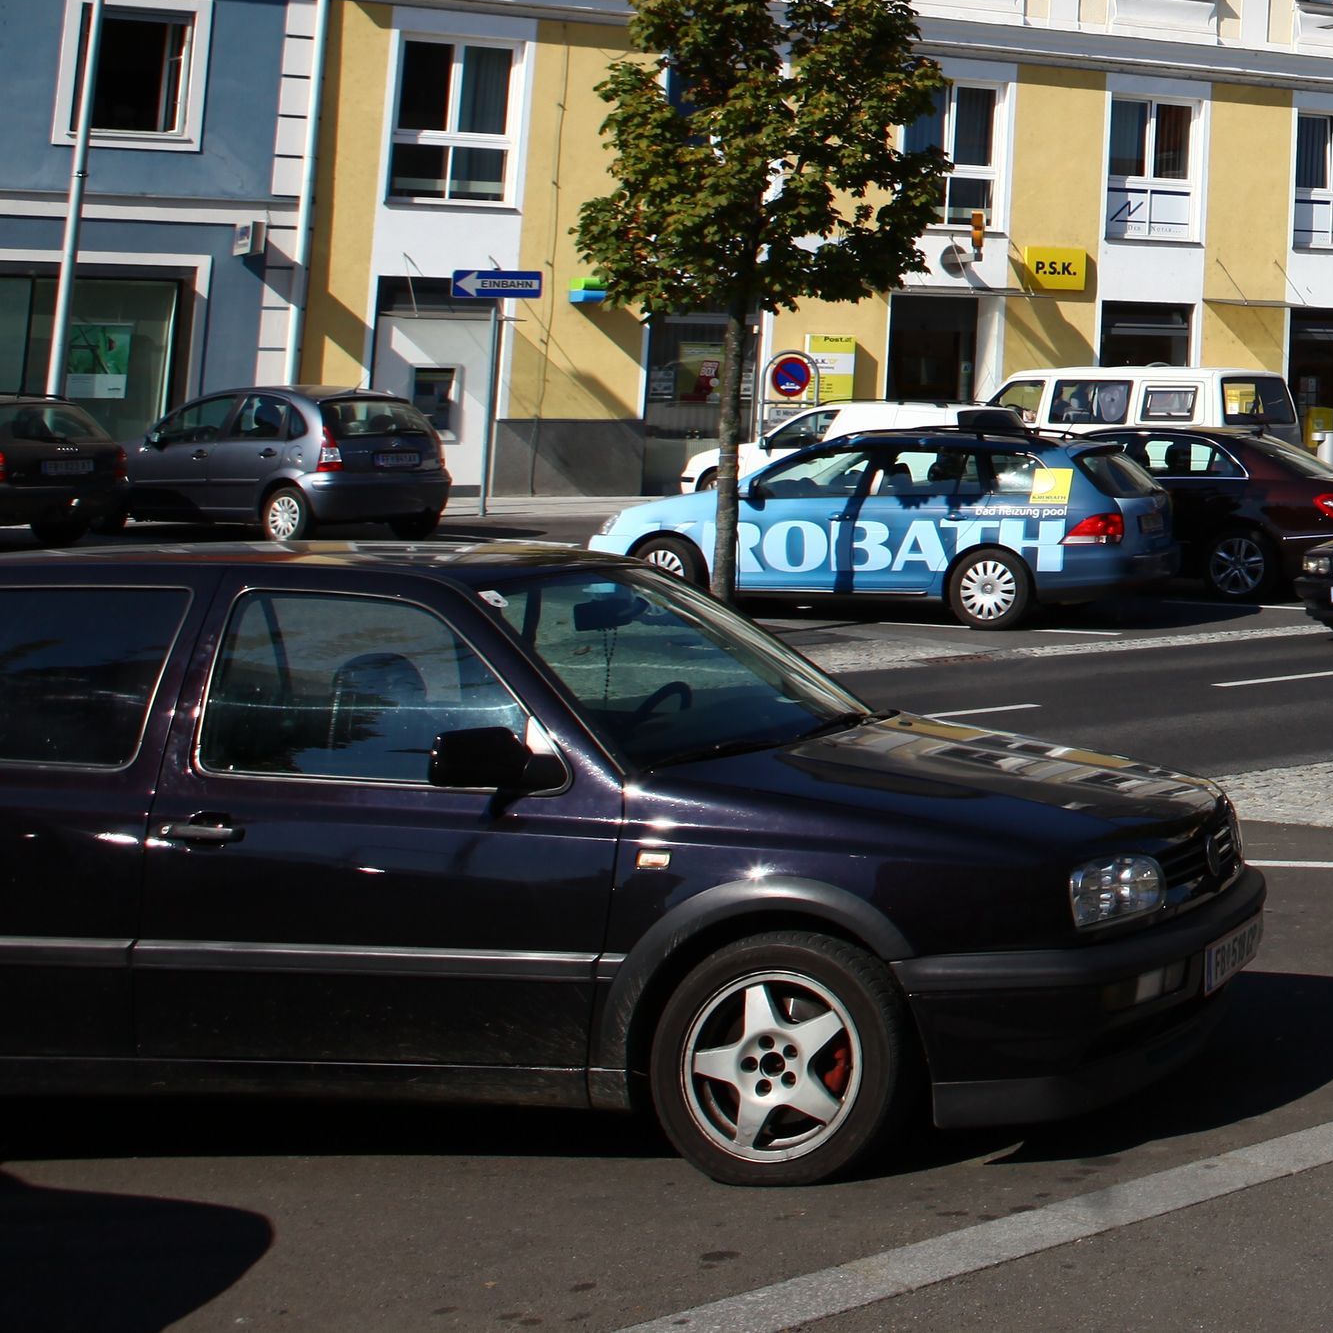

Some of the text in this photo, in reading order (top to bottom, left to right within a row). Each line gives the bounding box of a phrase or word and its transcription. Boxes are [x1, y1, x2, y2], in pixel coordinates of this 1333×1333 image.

[1035, 261, 1077, 276] P.S.K.
[480, 279, 534, 289] EINBAHN
[1042, 506, 1068, 518] pool
